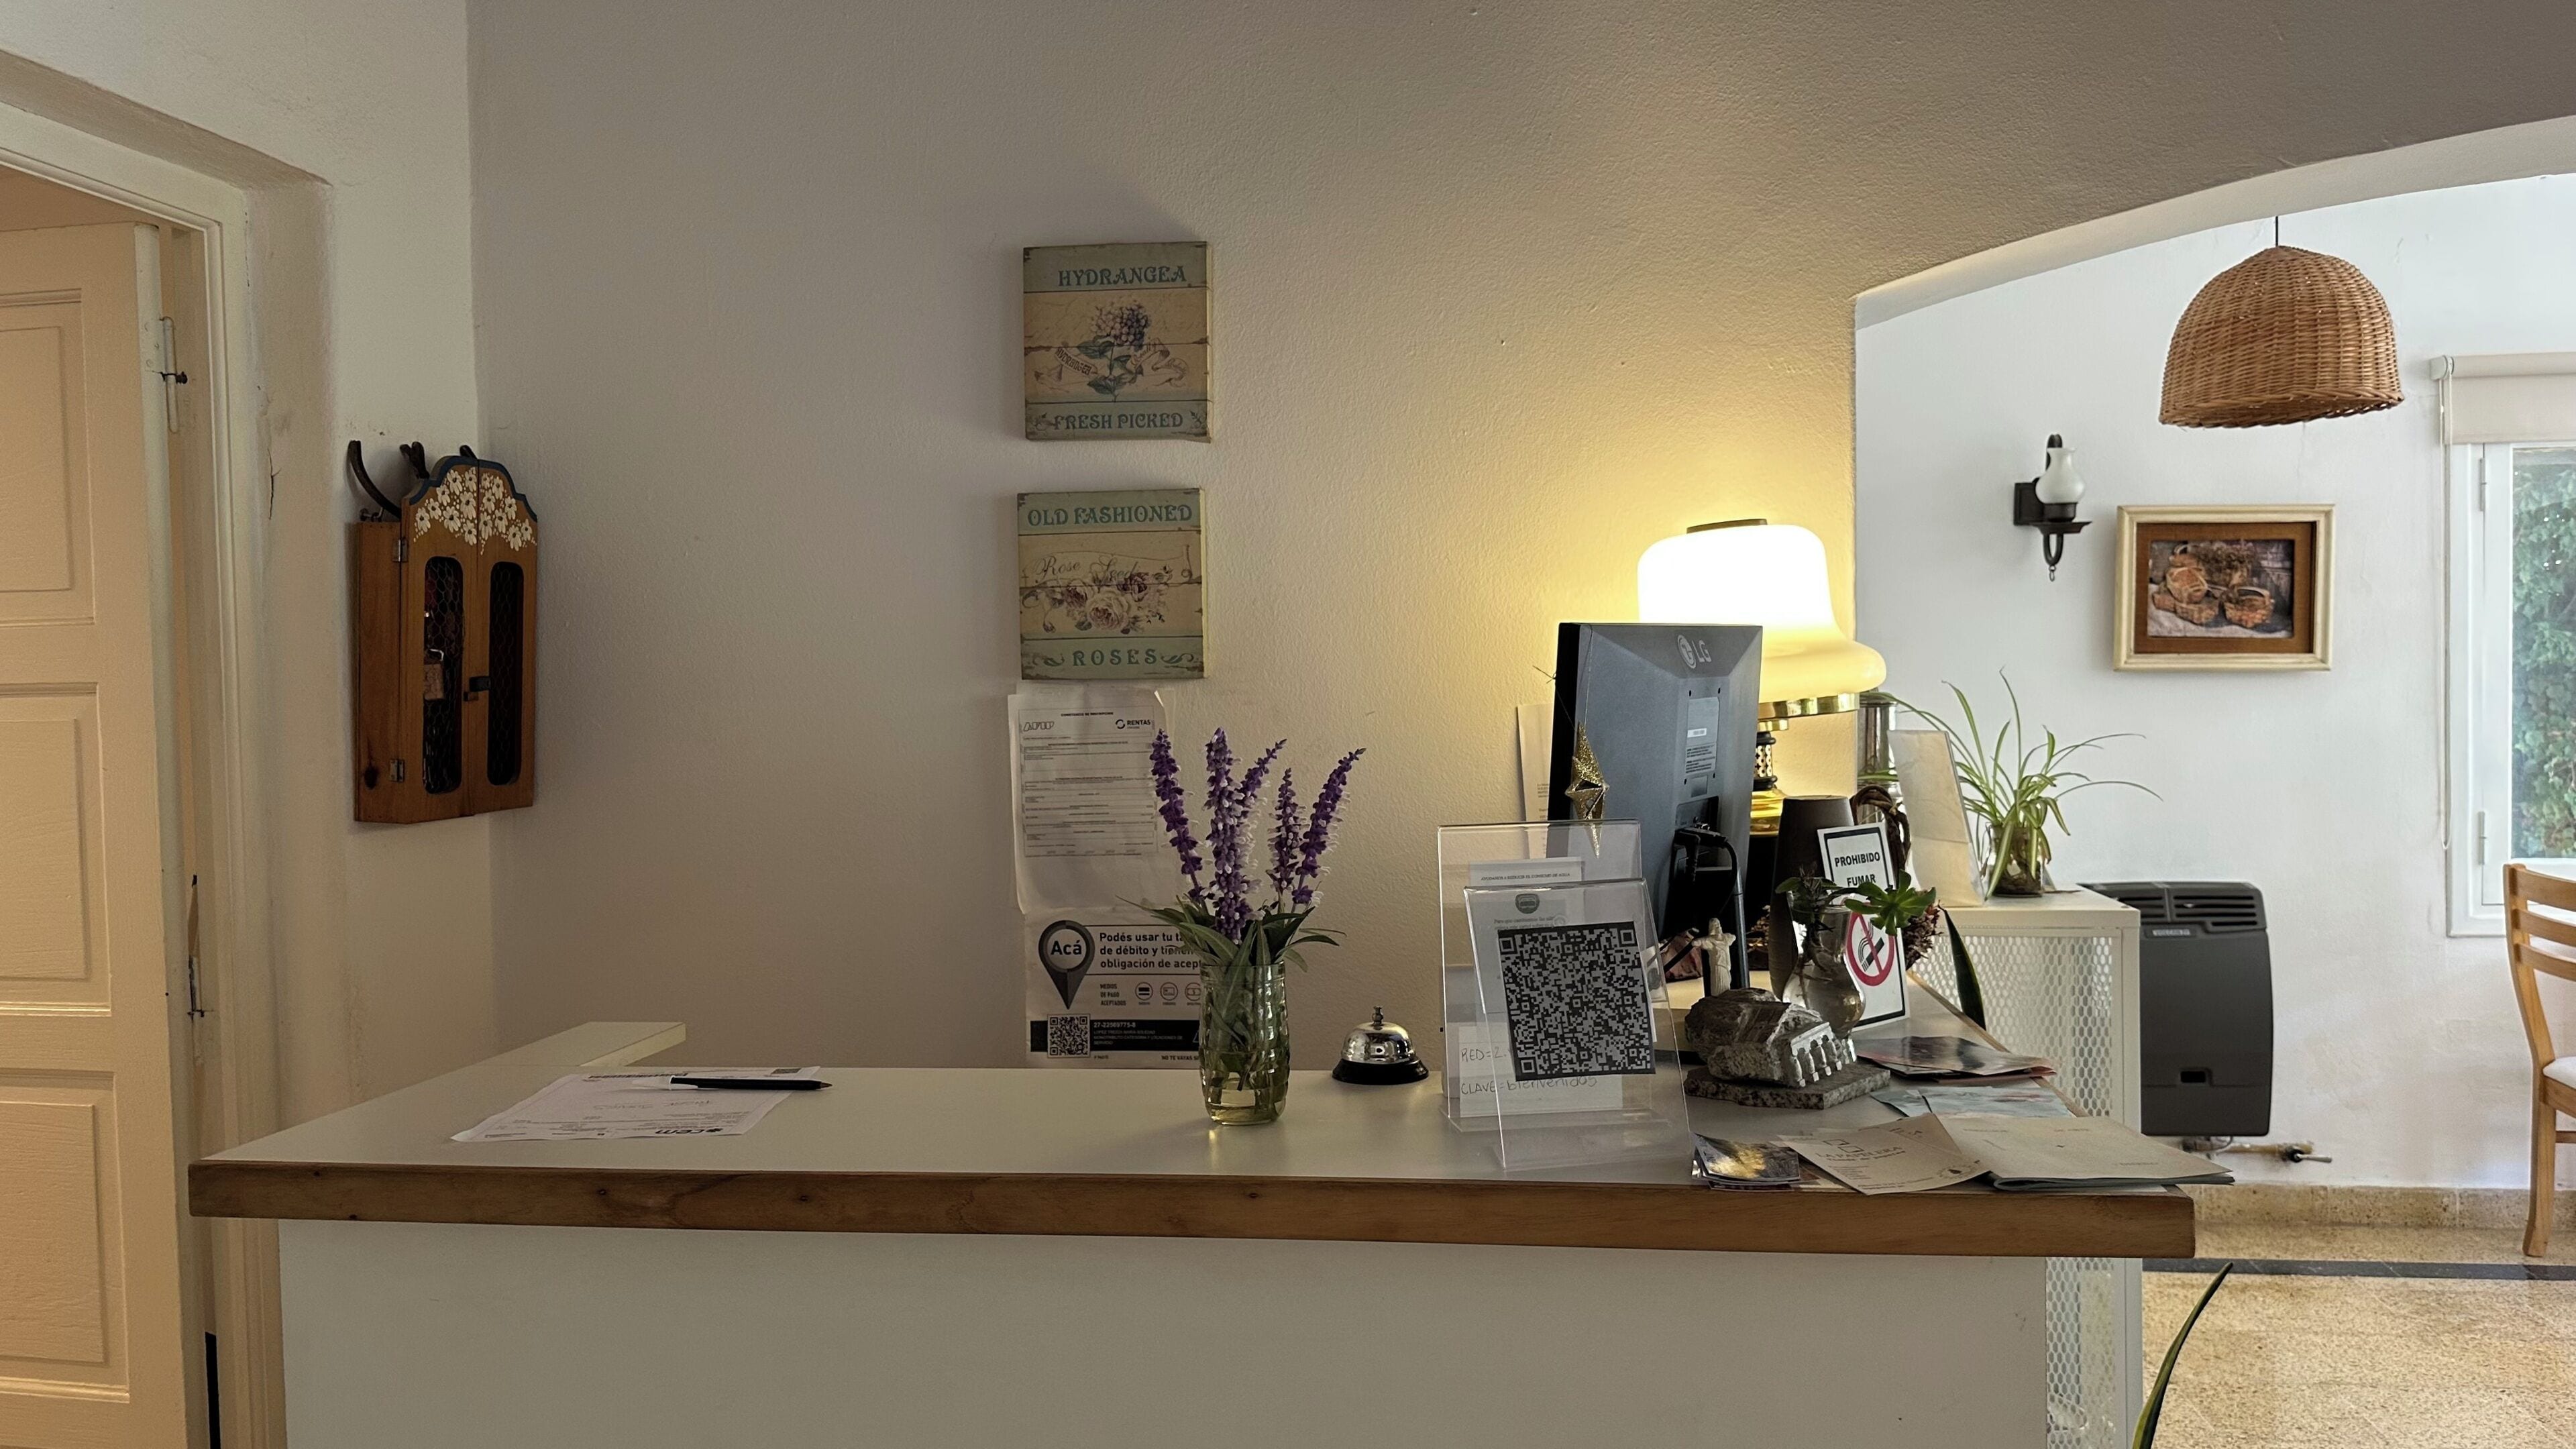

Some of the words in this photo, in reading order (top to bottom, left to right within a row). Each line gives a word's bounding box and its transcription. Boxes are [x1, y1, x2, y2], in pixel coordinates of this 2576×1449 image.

[1058, 266, 1187, 286] HYDRANGEA
[1054, 414, 1112, 430] FRESH
[1118, 413, 1183, 429] PICKED
[1028, 508, 1069, 526] OLD
[1074, 504, 1192, 525] FASHIONED
[1035, 555, 1081, 579] Rose
[1073, 649, 1157, 666] ROSES
[1692, 640, 1711, 662] LG
[1835, 851, 1880, 867] PROHIBIDO
[1847, 874, 1876, 887] FUMAR
[1099, 932, 1132, 942] Podés
[1162, 934, 1172, 942] tu
[1051, 940, 1082, 955] Acá
[1100, 946, 1112, 955] de
[1117, 946, 1148, 955] débito
[1152, 948, 1158, 957] y
[1100, 959, 1155, 969] obligación
[1158, 959, 1171, 968] de
[1174, 960, 1201, 970] acept
